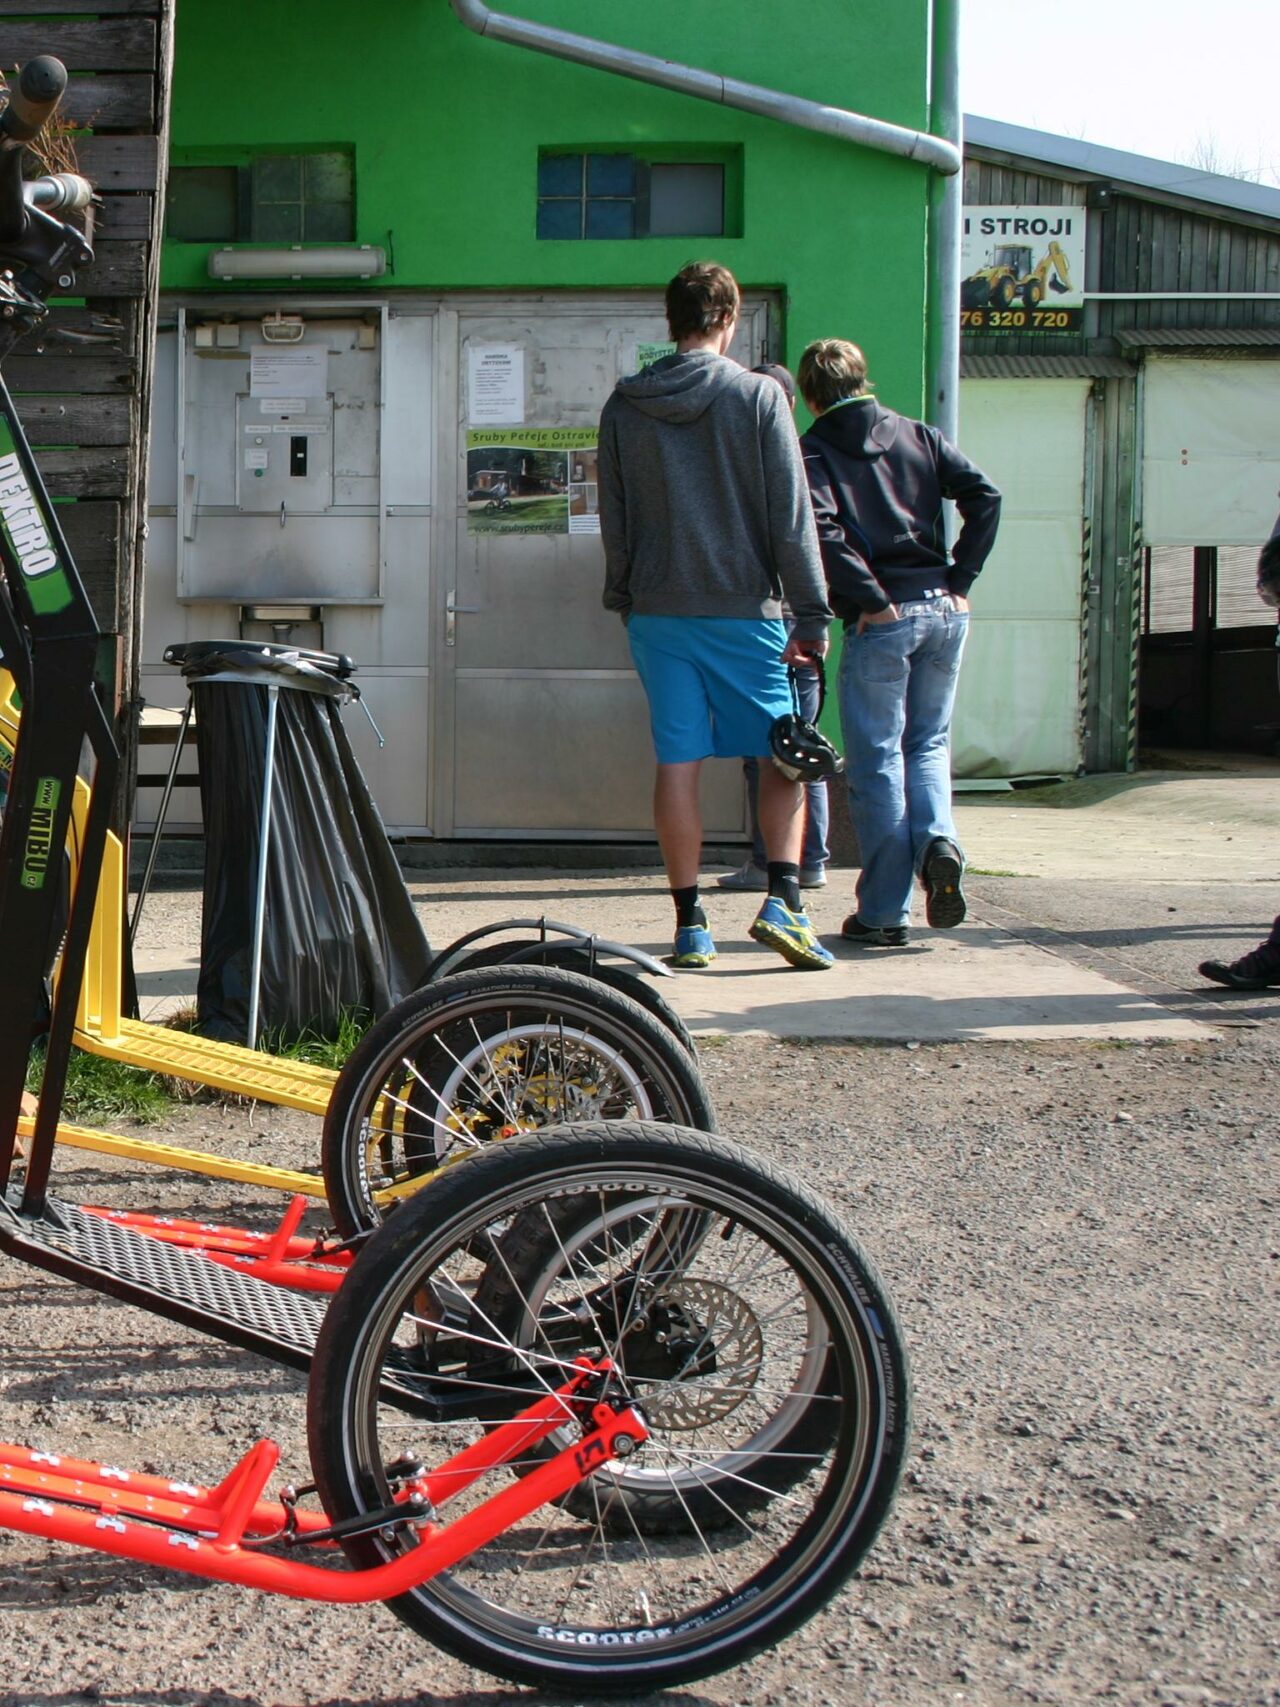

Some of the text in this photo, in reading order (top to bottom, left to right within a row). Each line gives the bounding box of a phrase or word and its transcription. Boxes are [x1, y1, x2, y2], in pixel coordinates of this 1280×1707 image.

[980, 217, 1072, 236] STROJI
[989, 311, 1025, 326] 320
[1032, 312, 1068, 327] 720
[473, 432, 506, 443] Sruby
[826, 1242, 872, 1304] SCHWALBE
[879, 1342, 895, 1399] MARATHON
[885, 1400, 898, 1434] RACER
